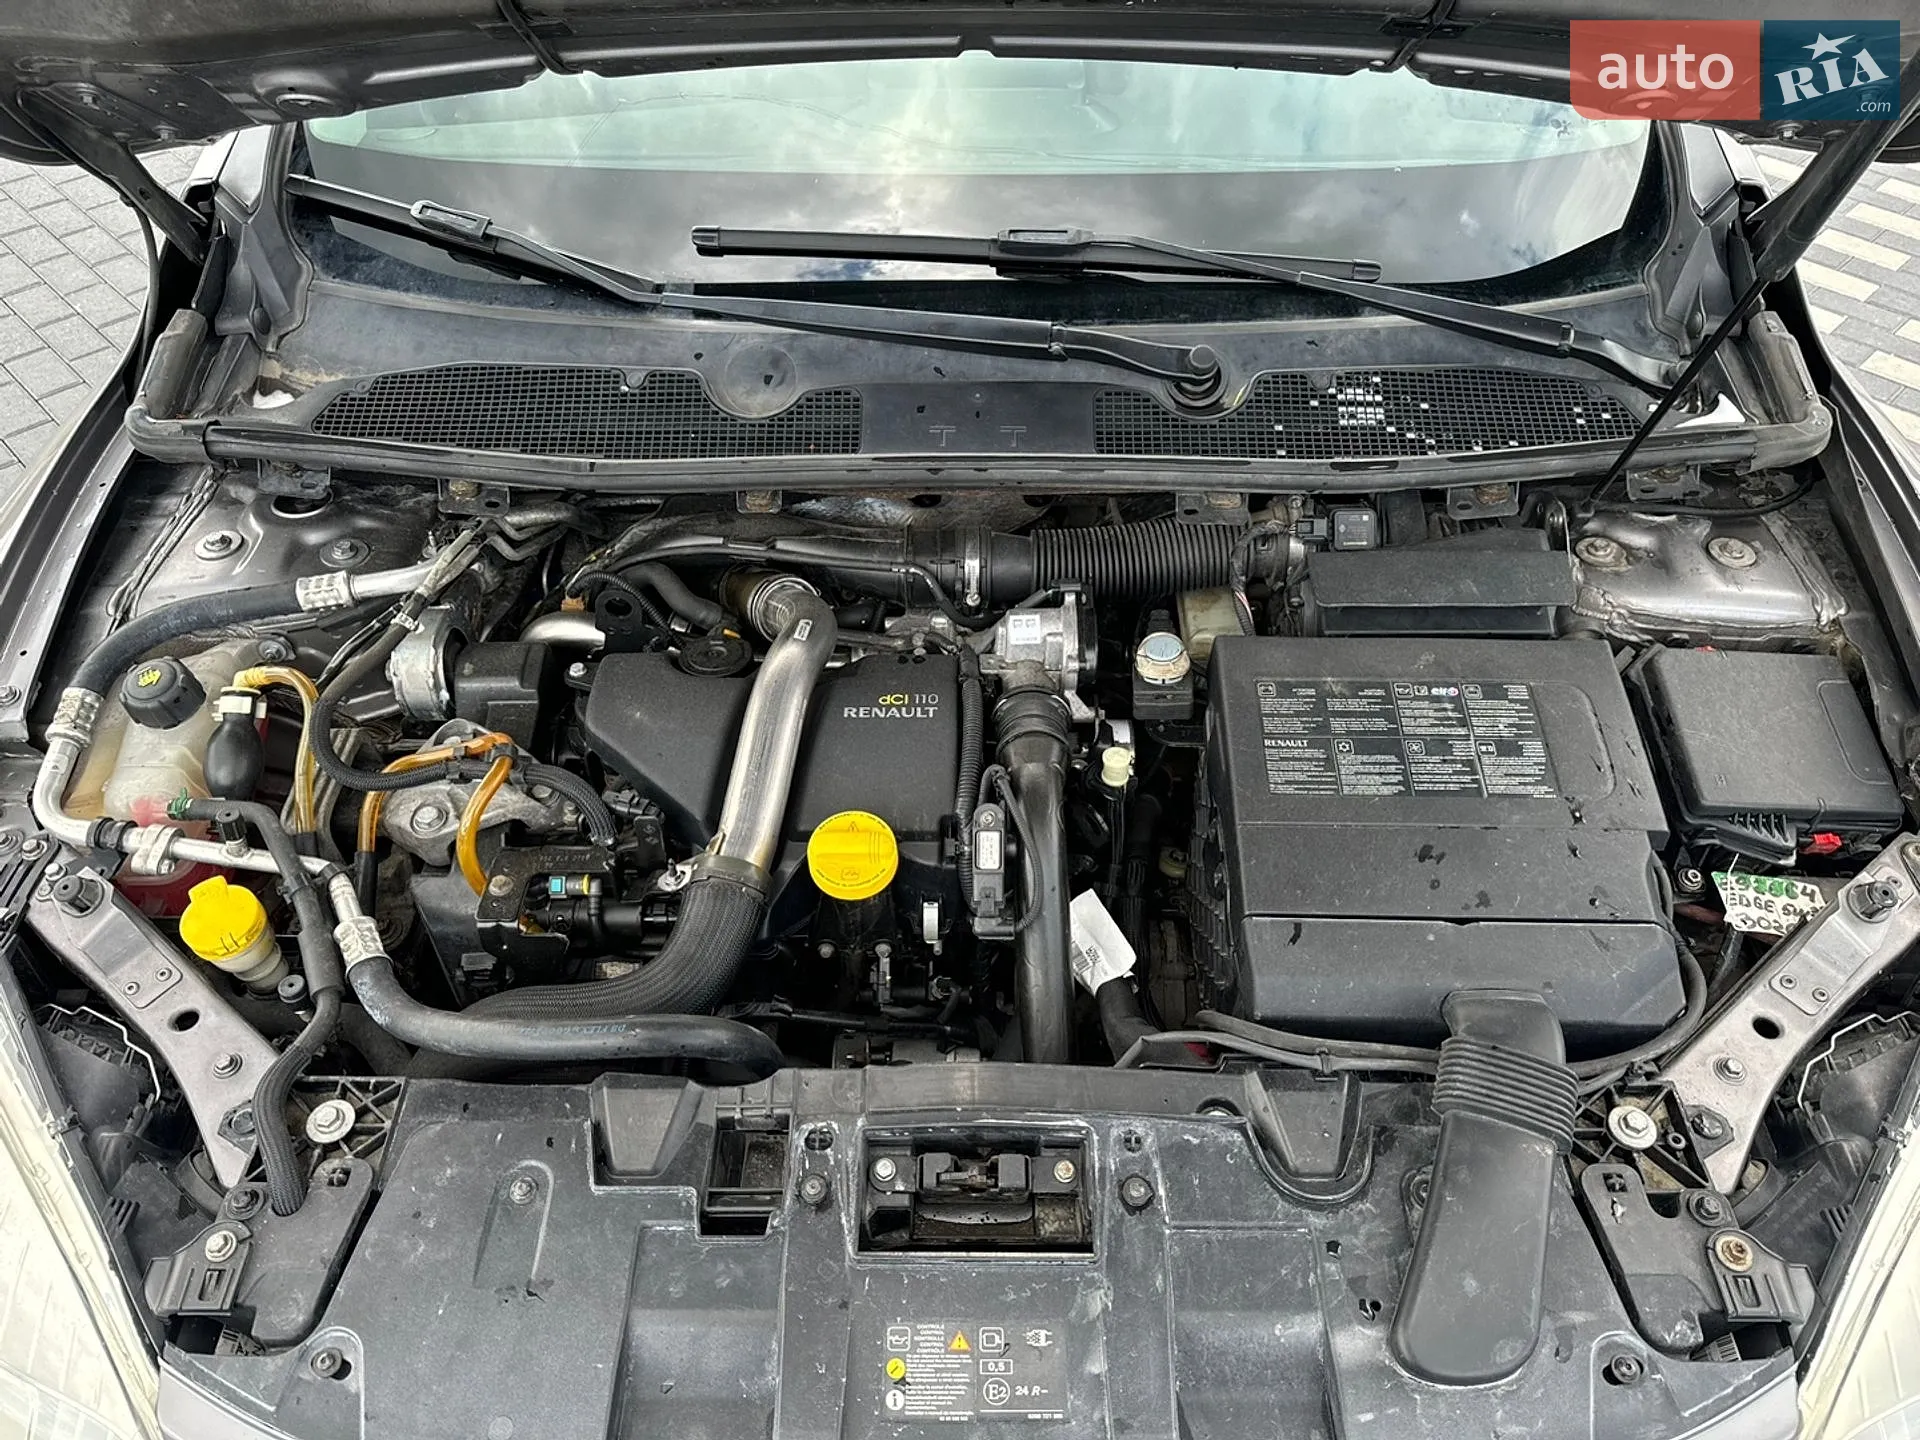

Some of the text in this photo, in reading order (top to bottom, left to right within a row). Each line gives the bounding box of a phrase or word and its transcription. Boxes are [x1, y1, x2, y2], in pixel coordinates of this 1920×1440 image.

[914, 693, 939, 705] 110
[843, 706, 939, 718] RENAULT
[1264, 739, 1309, 747] RENAULT
[987, 1384, 1008, 1401] E2
[1014, 1385, 1030, 1397] 24
